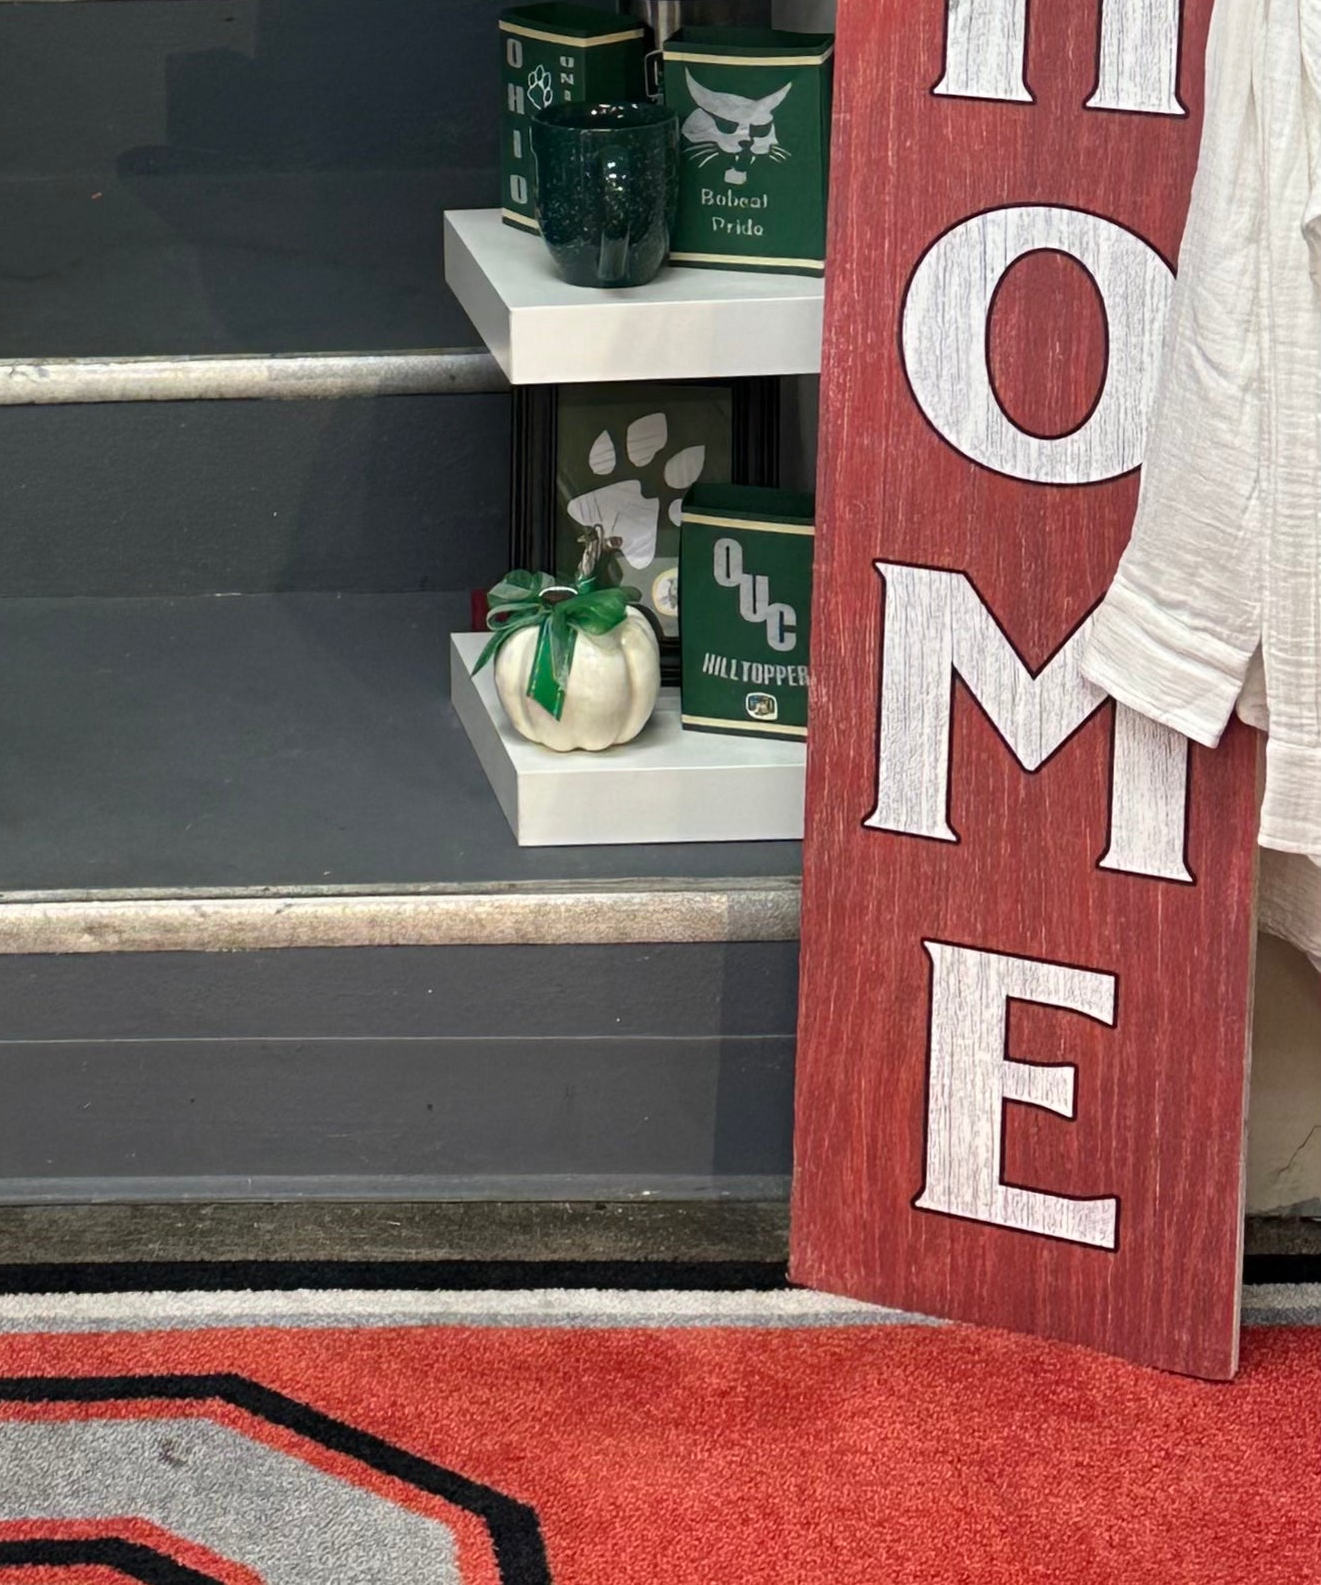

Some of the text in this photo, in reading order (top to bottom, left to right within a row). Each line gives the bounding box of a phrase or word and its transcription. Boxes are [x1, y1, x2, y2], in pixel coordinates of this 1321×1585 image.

[506, 37, 528, 204] OHIO
[701, 187, 768, 209] Bobcat
[712, 216, 764, 236] Pride
[713, 537, 797, 652] OUC
